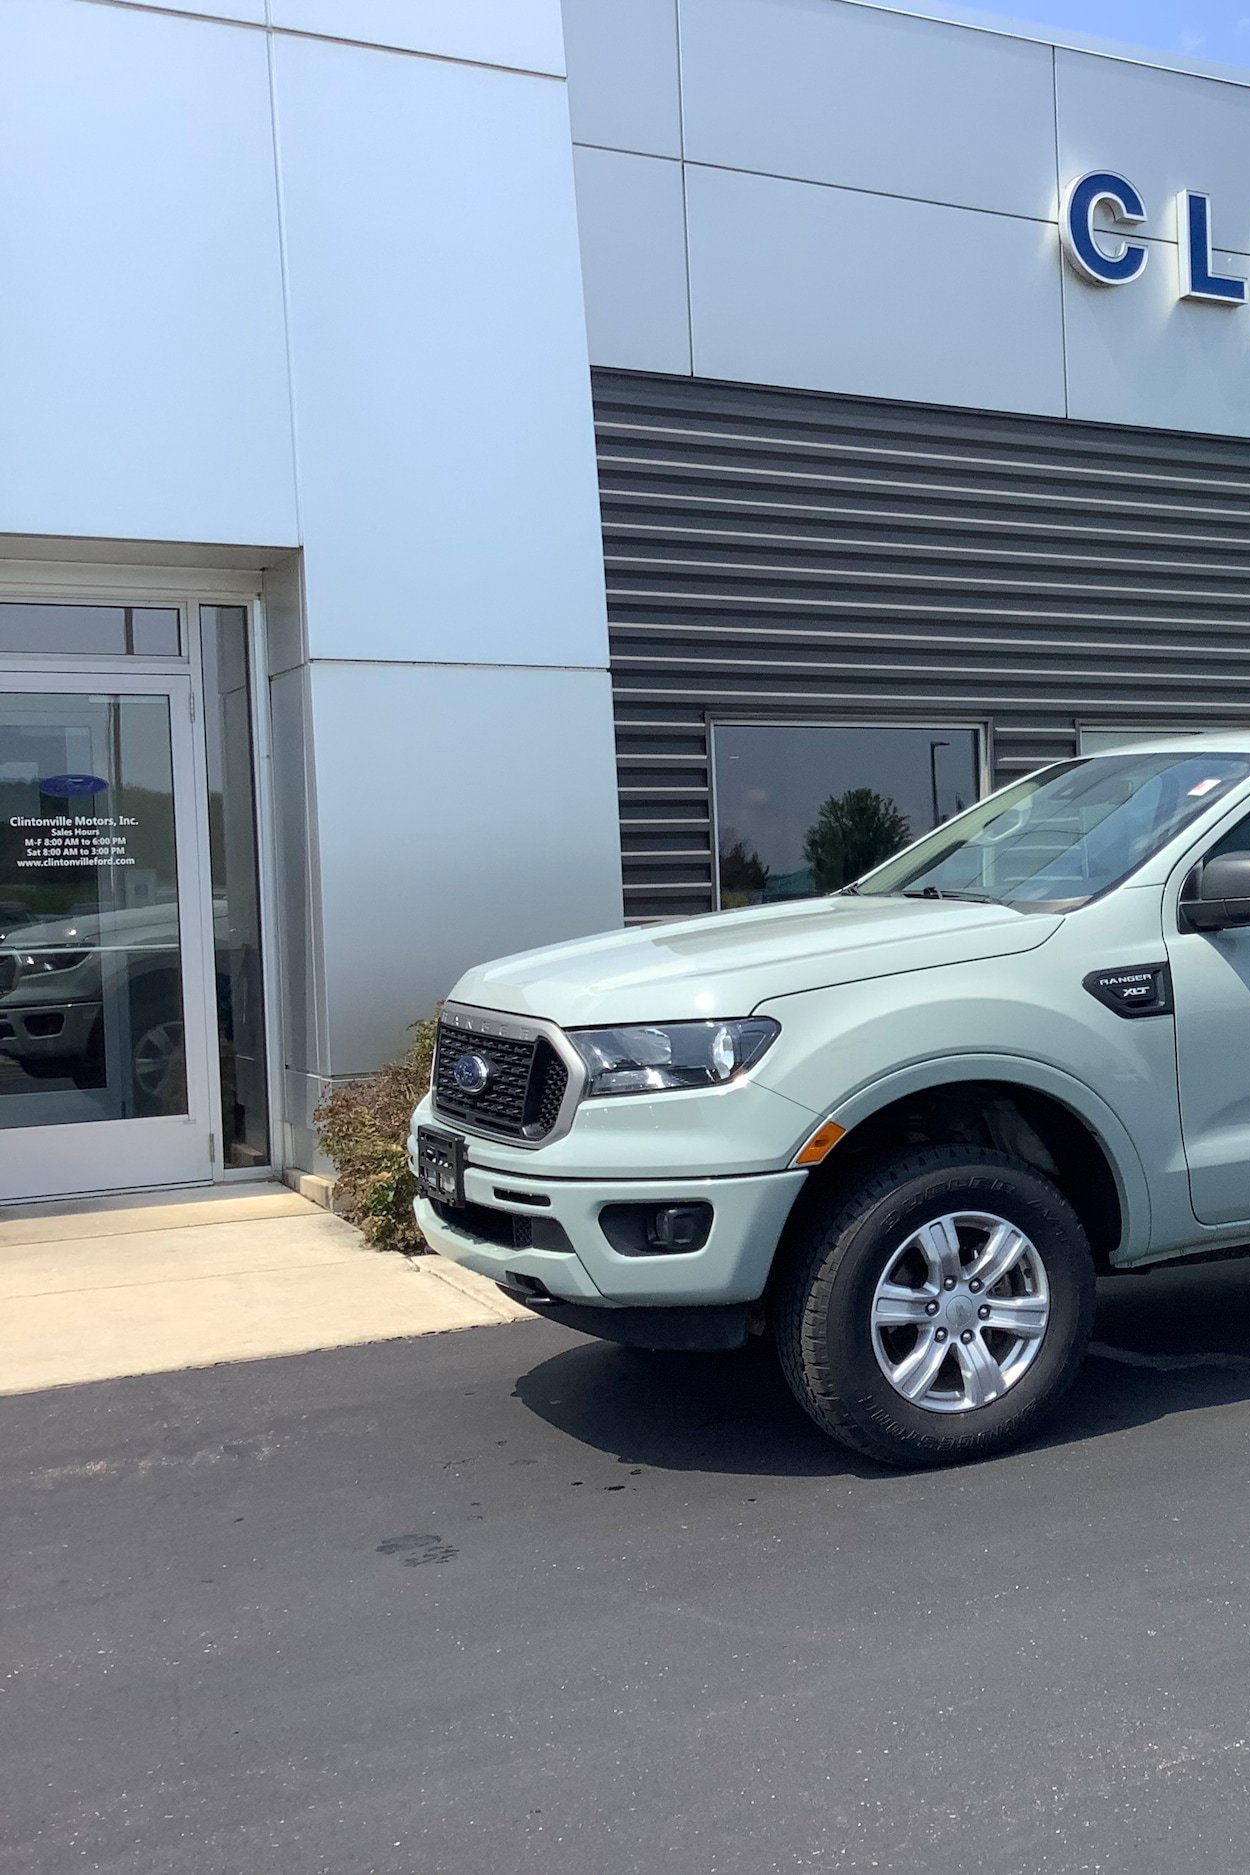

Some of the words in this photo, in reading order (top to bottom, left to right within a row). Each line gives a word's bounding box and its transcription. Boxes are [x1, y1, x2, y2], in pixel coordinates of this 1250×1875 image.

[9, 816, 72, 827] Clintonville
[75, 816, 117, 827] Motors,
[119, 815, 139, 826] Inc.
[51, 828, 73, 836] Sales
[74, 828, 100, 836] Hours
[24, 838, 42, 847] M-F
[44, 838, 62, 846] 8:00
[64, 838, 79, 846] AM
[81, 838, 91, 846] to
[92, 837, 111, 845] 6:00
[112, 837, 127, 845] PM
[26, 848, 41, 857] Sat
[43, 848, 61, 856] 8:00
[63, 848, 78, 856] AM
[80, 848, 89, 856] to
[91, 847, 109, 855] 3:00
[110, 847, 125, 855] PM
[17, 857, 135, 868] www.clintonvilleford.com
[1099, 973, 1152, 986] RANGER
[1122, 986, 1150, 997] XLT
